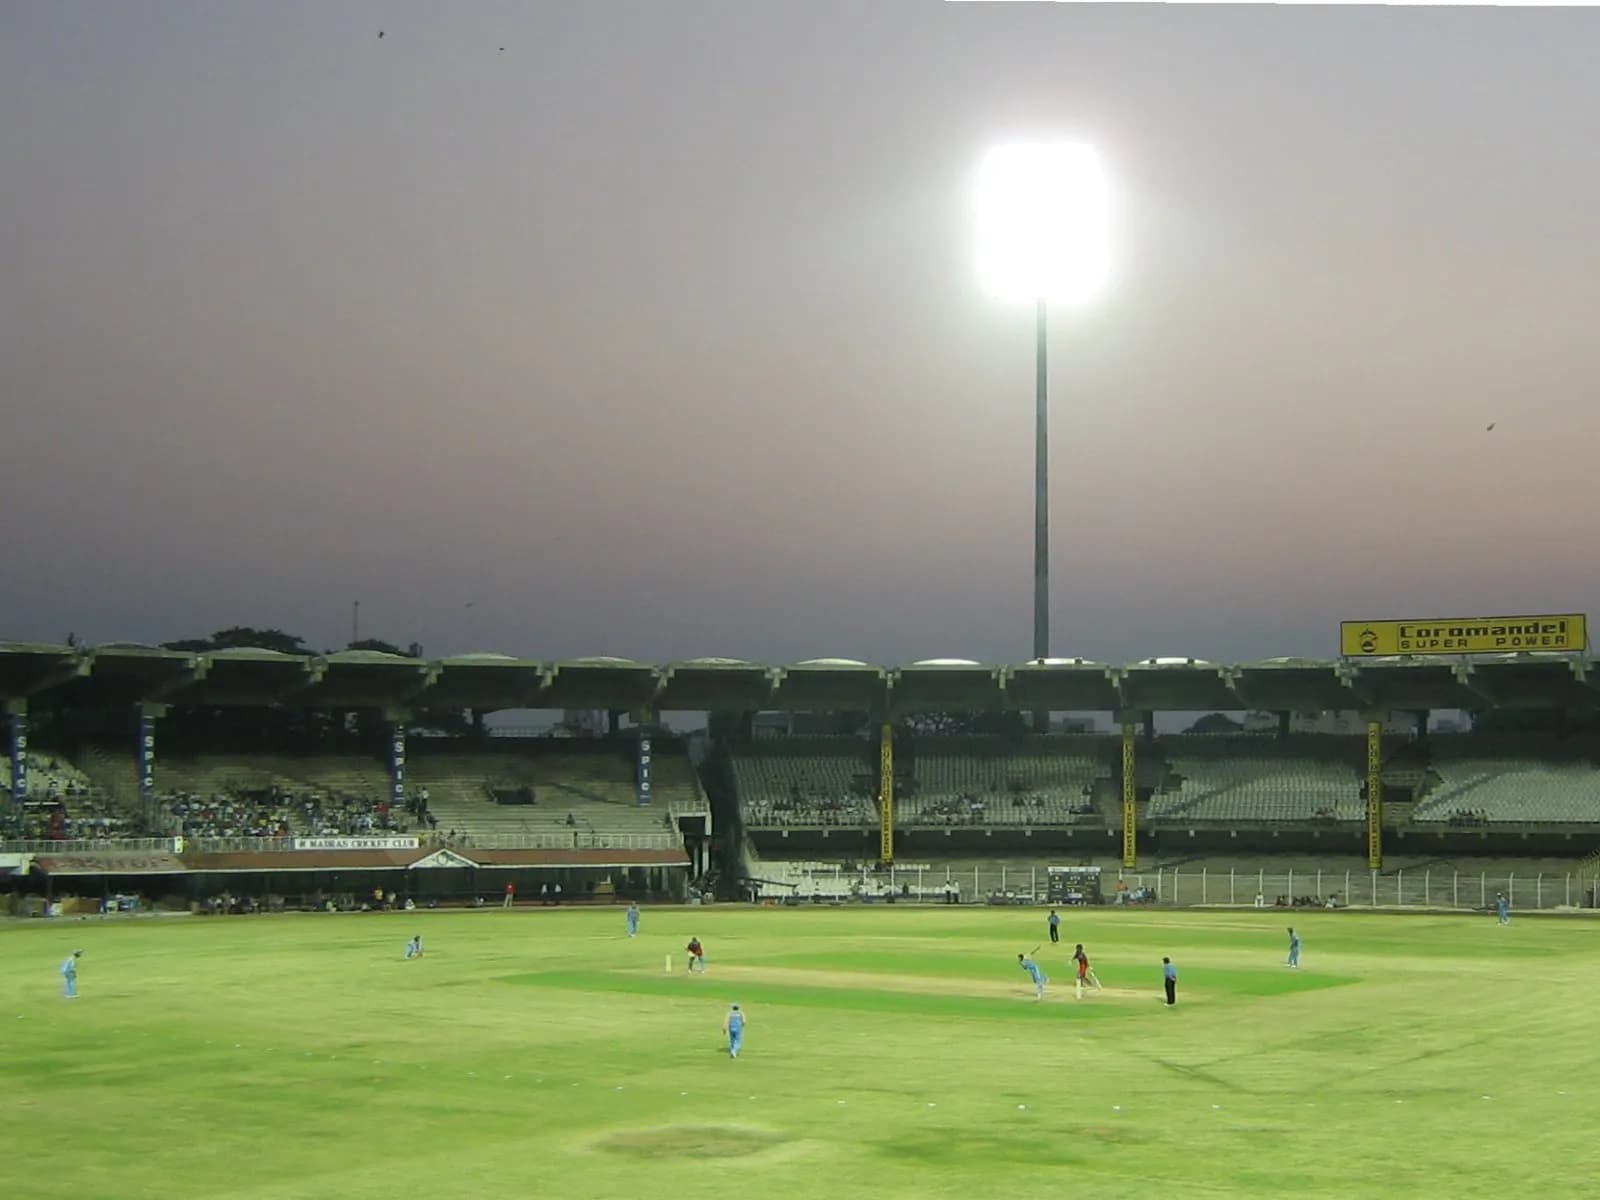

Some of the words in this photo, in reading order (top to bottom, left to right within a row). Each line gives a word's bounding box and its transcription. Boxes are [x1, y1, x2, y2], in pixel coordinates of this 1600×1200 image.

[1400, 621, 1566, 639] Coromandel
[1401, 638, 1467, 649] SUPER
[1496, 636, 1565, 647] POWER
[16, 735, 27, 788] SPIC
[144, 735, 154, 786] SPIC
[395, 741, 405, 793] SPIC
[641, 740, 651, 791] SPIC
